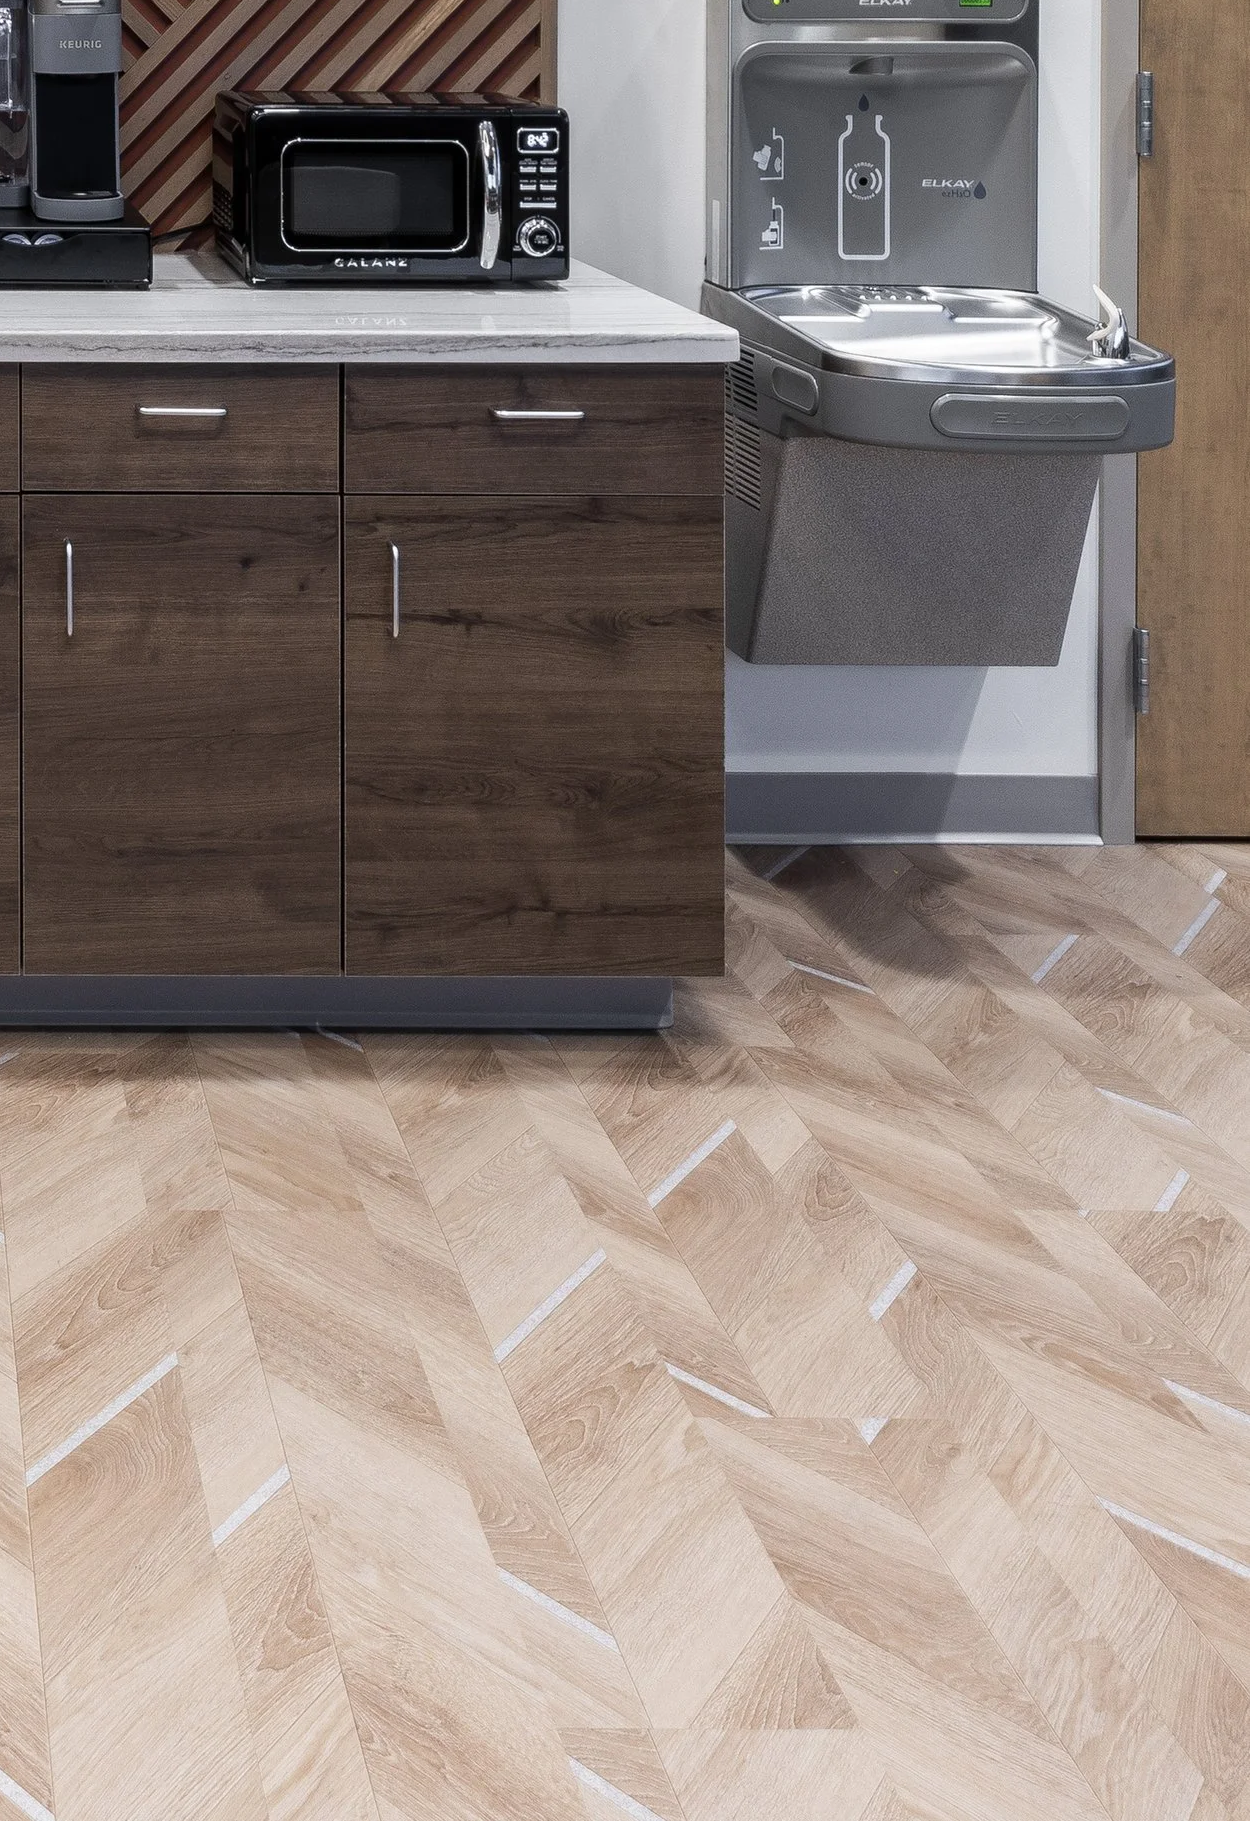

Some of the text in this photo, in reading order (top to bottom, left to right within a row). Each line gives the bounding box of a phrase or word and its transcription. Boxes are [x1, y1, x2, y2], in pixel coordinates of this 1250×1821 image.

[59, 40, 102, 49] KEURIG
[922, 179, 975, 188] ELKAY
[334, 258, 408, 267] GALANZ
[991, 411, 1084, 426] ELKAY
